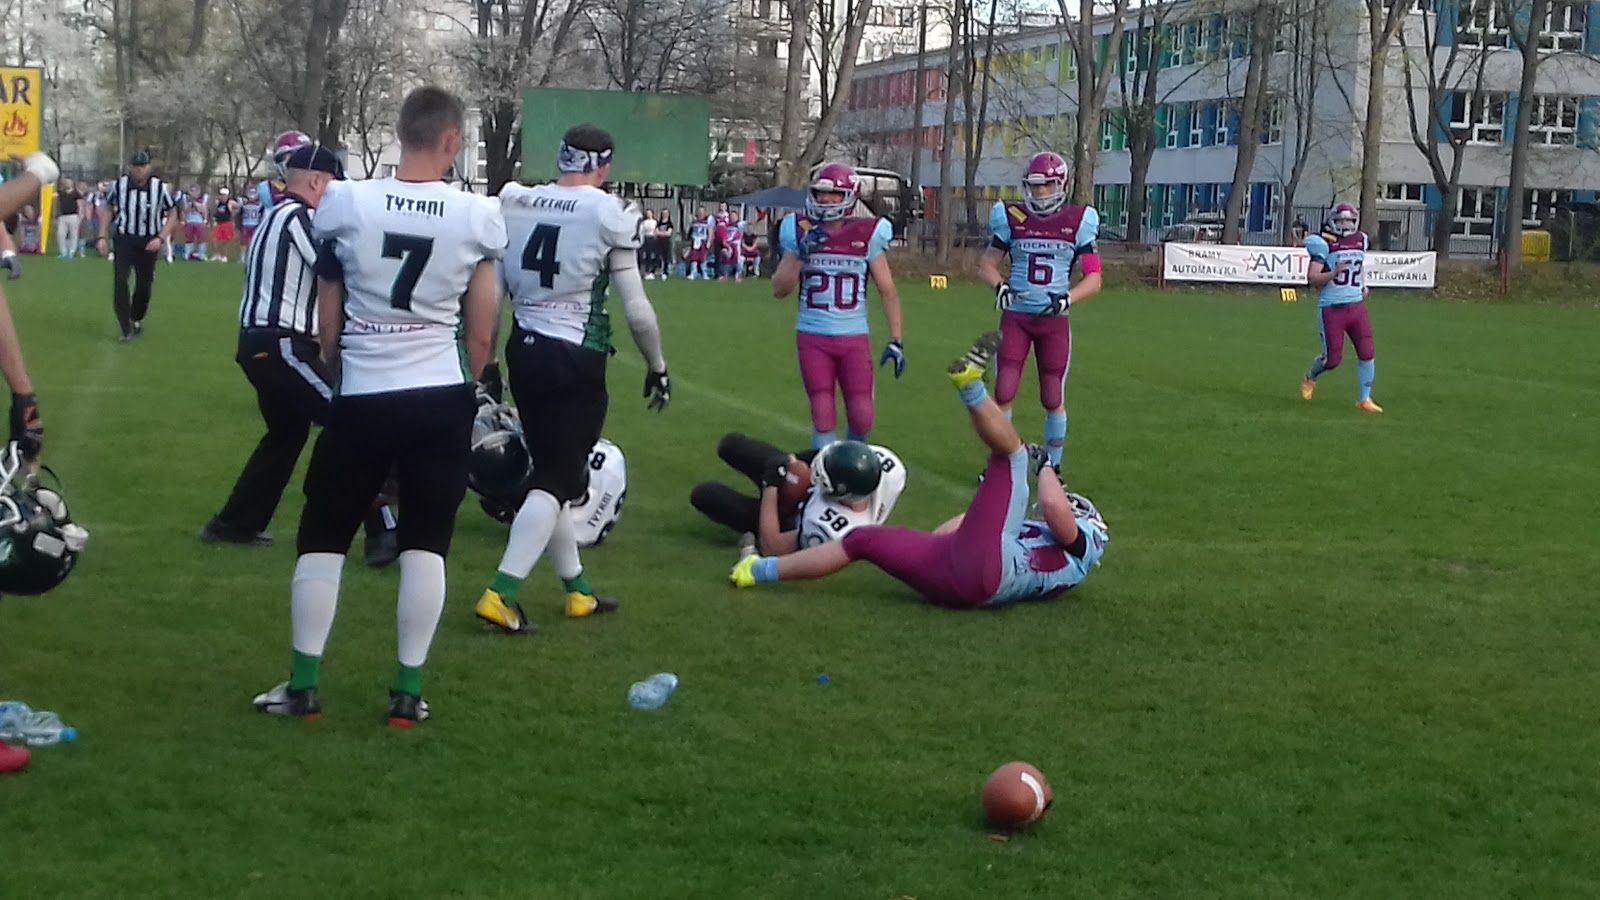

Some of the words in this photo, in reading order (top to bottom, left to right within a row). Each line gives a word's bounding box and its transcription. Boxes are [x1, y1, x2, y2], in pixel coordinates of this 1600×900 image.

[386, 194, 444, 218] TYTANI
[521, 222, 561, 290] 4
[1189, 250, 1221, 259] BRAMY
[1253, 253, 1308, 273] AMT
[381, 231, 434, 312] 7
[1028, 253, 1055, 286] 6
[1172, 264, 1237, 276] AUTOMATYKA
[1367, 271, 1428, 281] STEROWANIA
[807, 272, 859, 311] 20
[819, 507, 849, 532] 58
